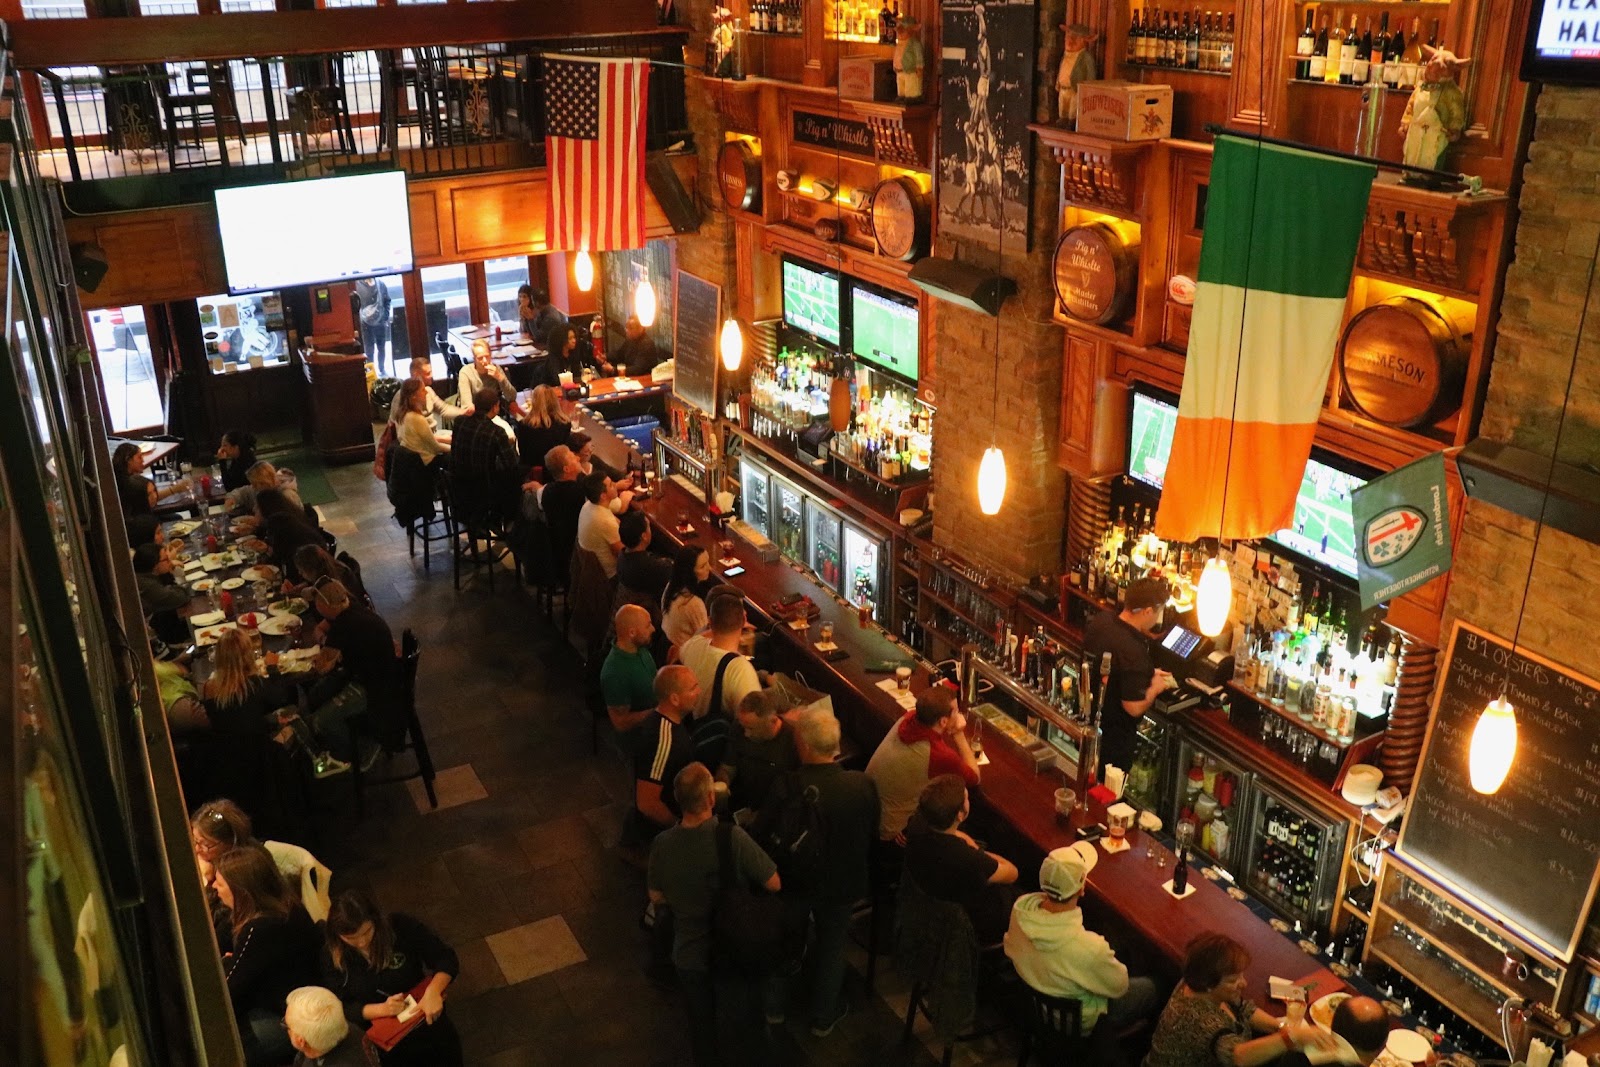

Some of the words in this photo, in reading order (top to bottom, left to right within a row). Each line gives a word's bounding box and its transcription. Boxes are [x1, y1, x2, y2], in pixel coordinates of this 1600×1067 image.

[805, 117, 820, 142] Pig
[832, 122, 869, 147] Whistle
[1075, 239, 1090, 256] Pig
[1071, 254, 1102, 273] Whistle
[1074, 286, 1097, 301] Master
[1494, 649, 1548, 684] OYSTERS
[1454, 657, 1480, 680] Soup
[1556, 707, 1581, 727] BASIL
